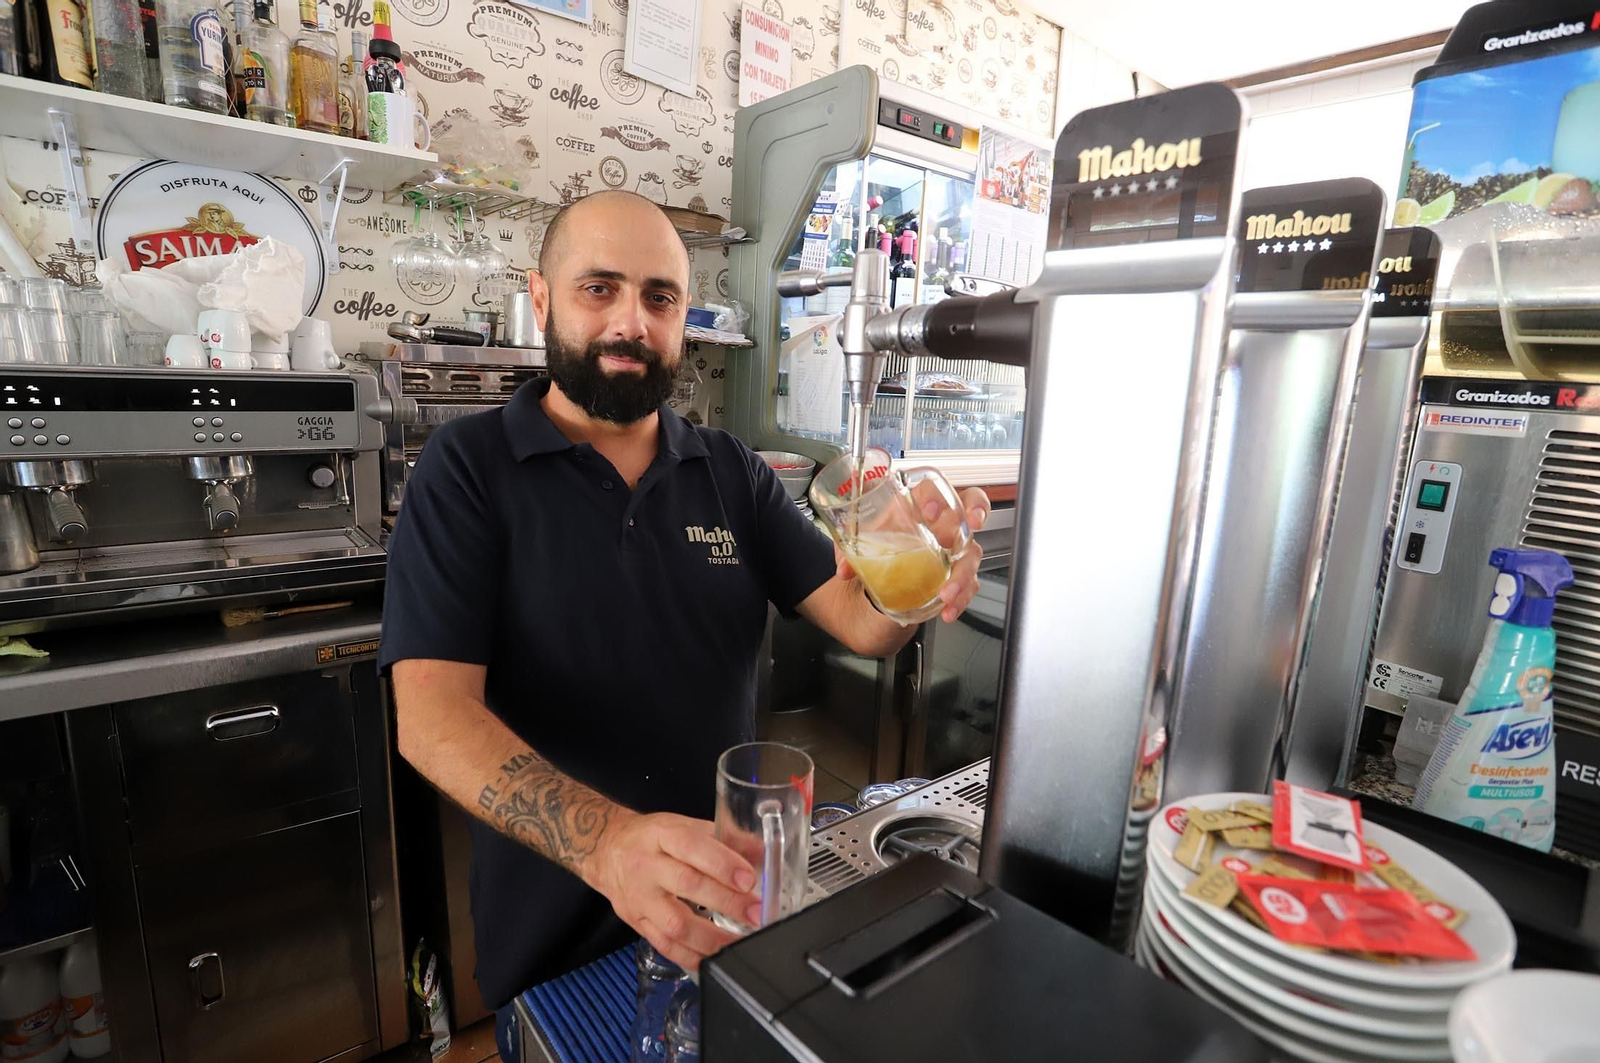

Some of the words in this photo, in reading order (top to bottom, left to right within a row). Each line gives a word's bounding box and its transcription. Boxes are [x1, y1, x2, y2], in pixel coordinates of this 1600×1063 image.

[479, 5, 533, 28] PREMIUM
[908, 10, 935, 32] coffee
[491, 35, 524, 51] GENUINE
[1484, 21, 1586, 52] Granizados
[413, 50, 463, 70] PREMIUM
[425, 60, 452, 72] COFFEE
[417, 64, 460, 82] NATURAL
[744, 61, 759, 81] CON
[550, 83, 600, 111] coffee
[617, 124, 654, 139] PREMIUM
[556, 137, 595, 153] COFFEE
[1078, 137, 1202, 183] Mahou
[160, 177, 228, 193] DISFRUTA
[232, 185, 265, 205] AQUÍ
[367, 216, 407, 234] AWESOME
[1246, 210, 1352, 240] Mahou
[343, 288, 358, 298] THE
[334, 291, 399, 321] coffee
[1455, 388, 1551, 405] Granizados
[297, 416, 334, 426] GAGGIA
[711, 542, 733, 557] 0,0
[1470, 763, 1550, 779] Desinfectante
[1480, 787, 1537, 798] MULTIUSOS
